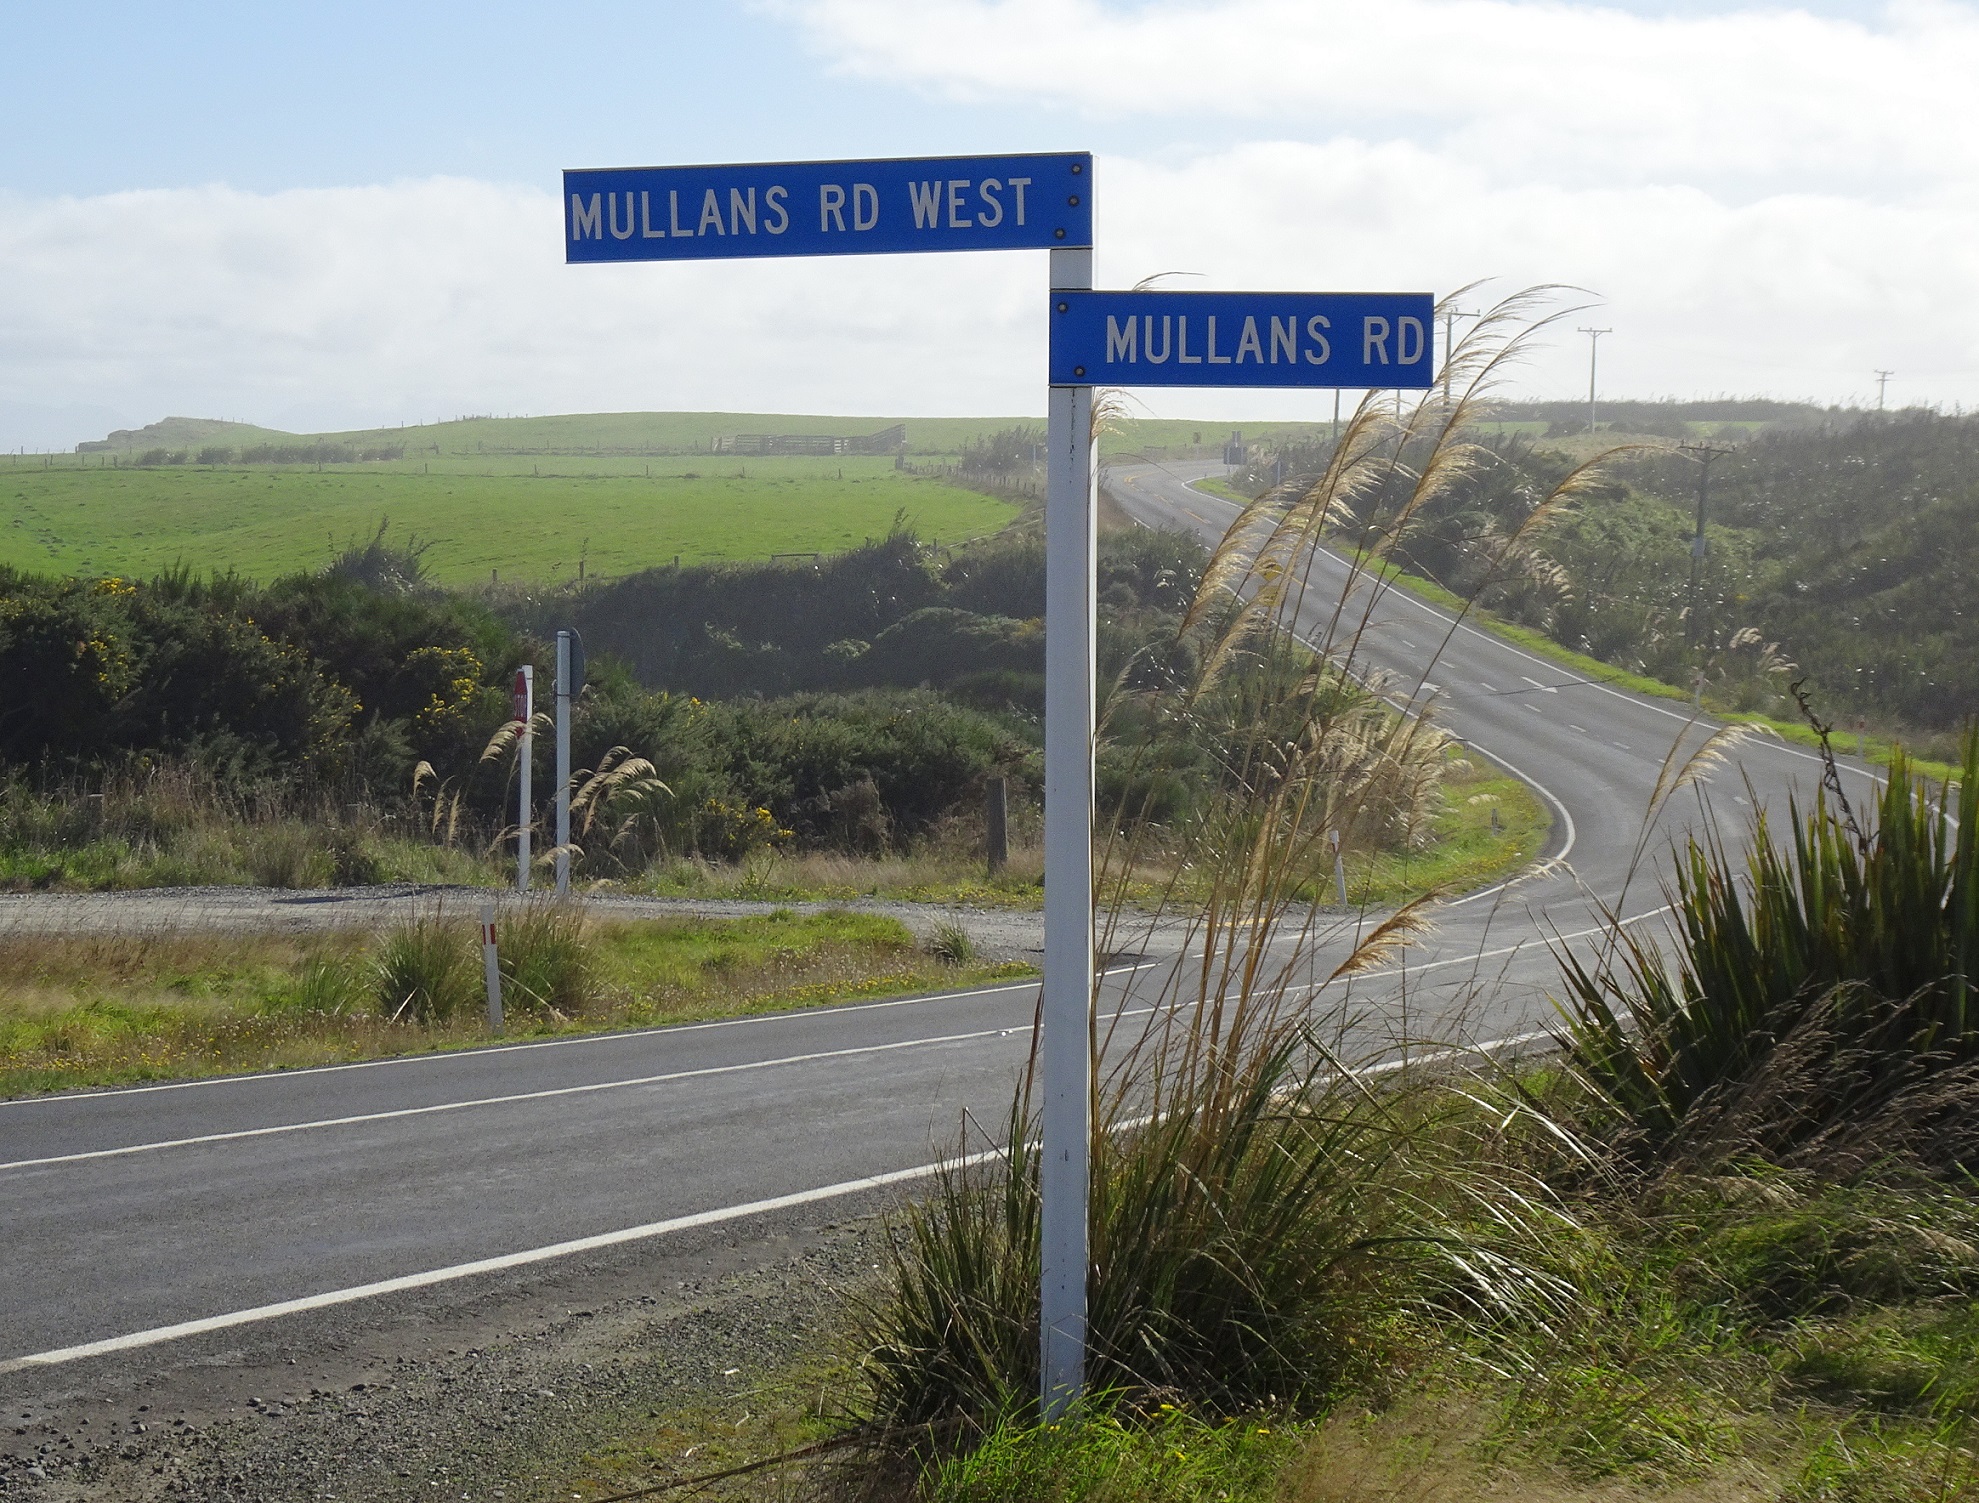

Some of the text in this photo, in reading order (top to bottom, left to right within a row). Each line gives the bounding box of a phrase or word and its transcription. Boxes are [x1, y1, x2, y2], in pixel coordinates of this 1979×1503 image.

[571, 177, 1032, 241] MULLANS RD WEST
[1106, 315, 1424, 365] MULLANS RD
